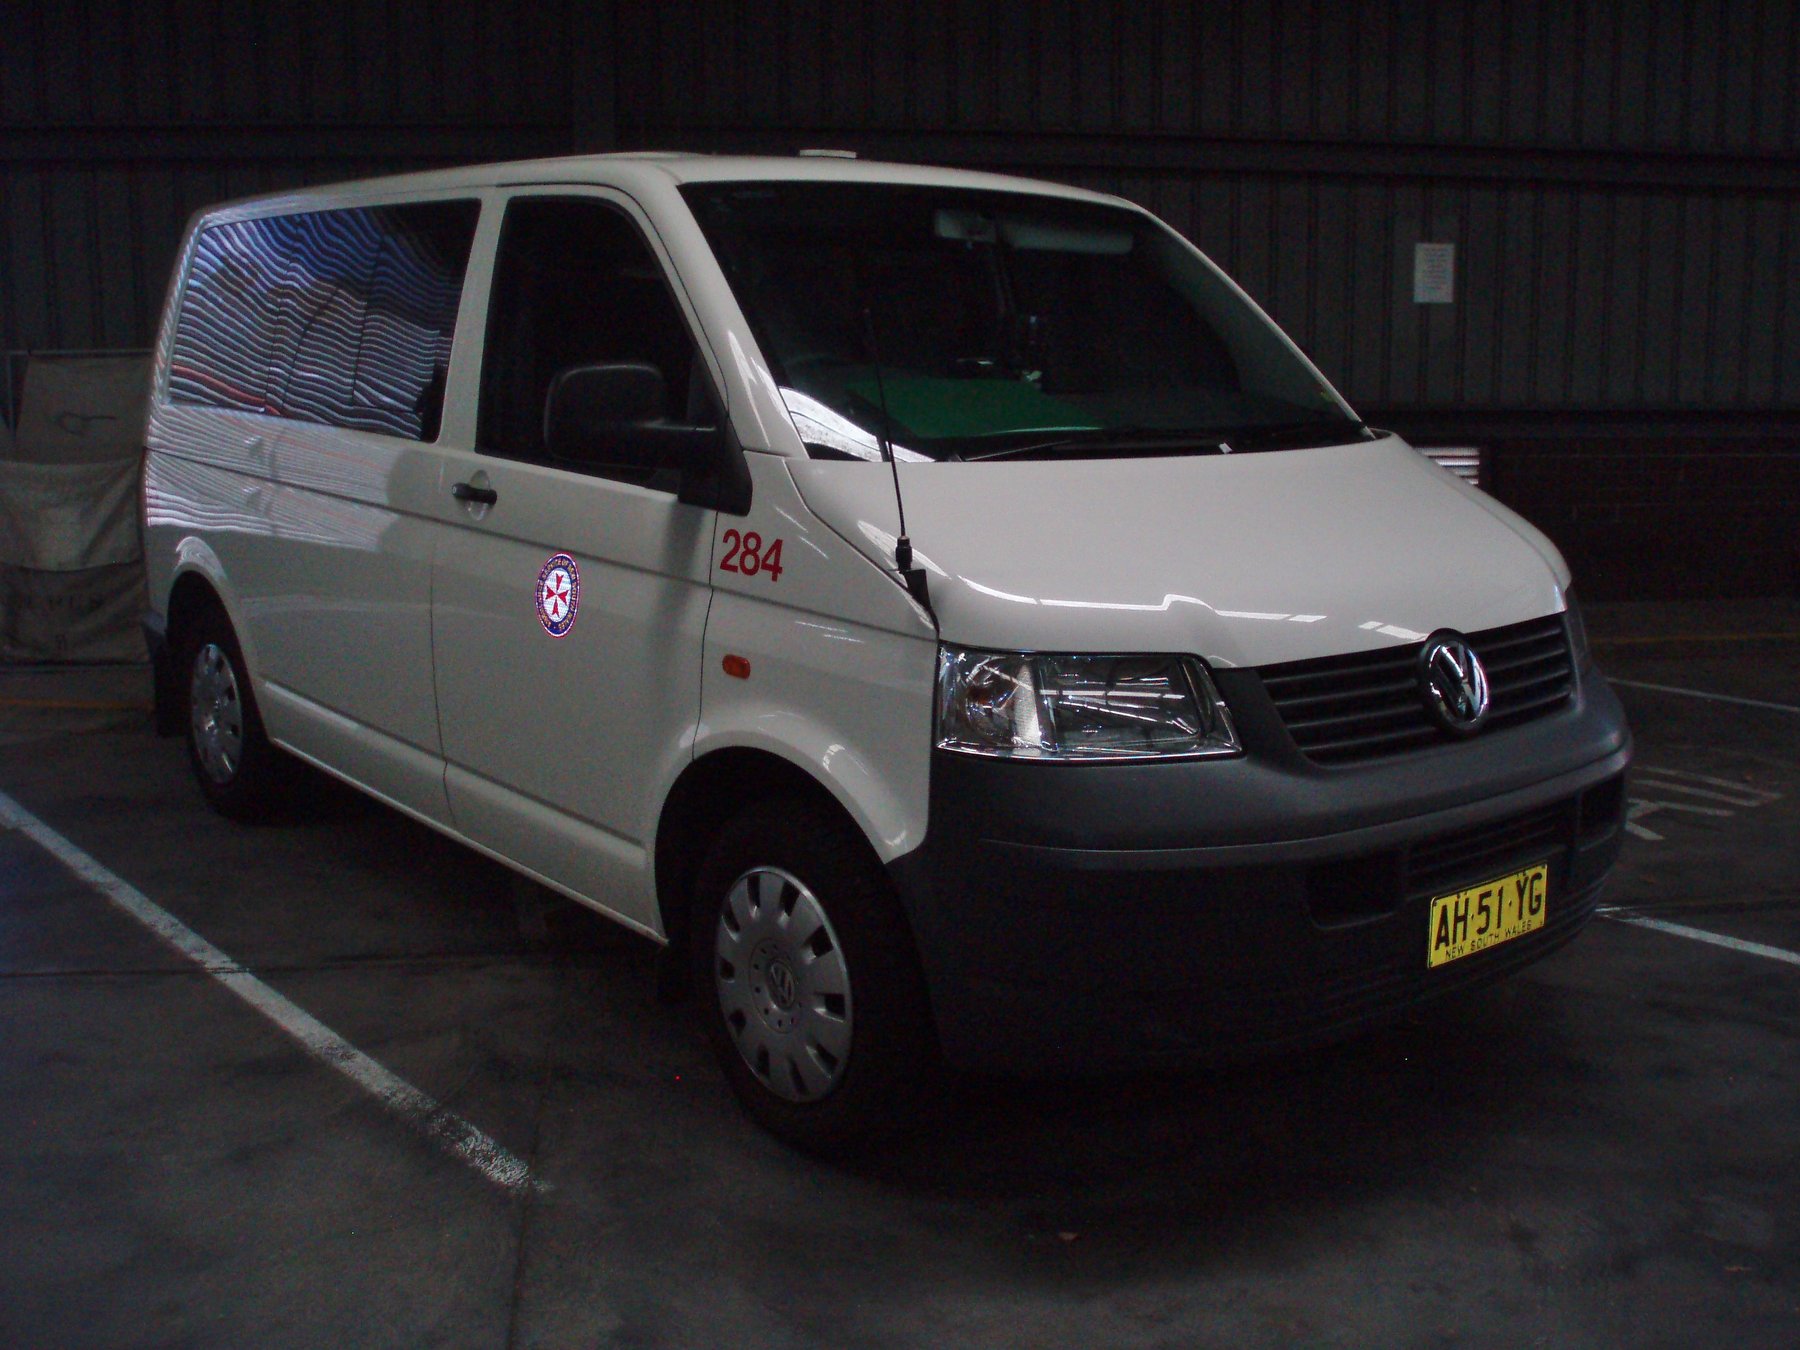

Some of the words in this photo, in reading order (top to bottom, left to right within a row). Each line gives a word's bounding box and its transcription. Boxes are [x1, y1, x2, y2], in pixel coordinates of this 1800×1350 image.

[719, 528, 783, 582] 284
[1445, 946, 1464, 961] NEW
[1470, 932, 1499, 951] SOUTH
[1505, 919, 1533, 938] WALES
